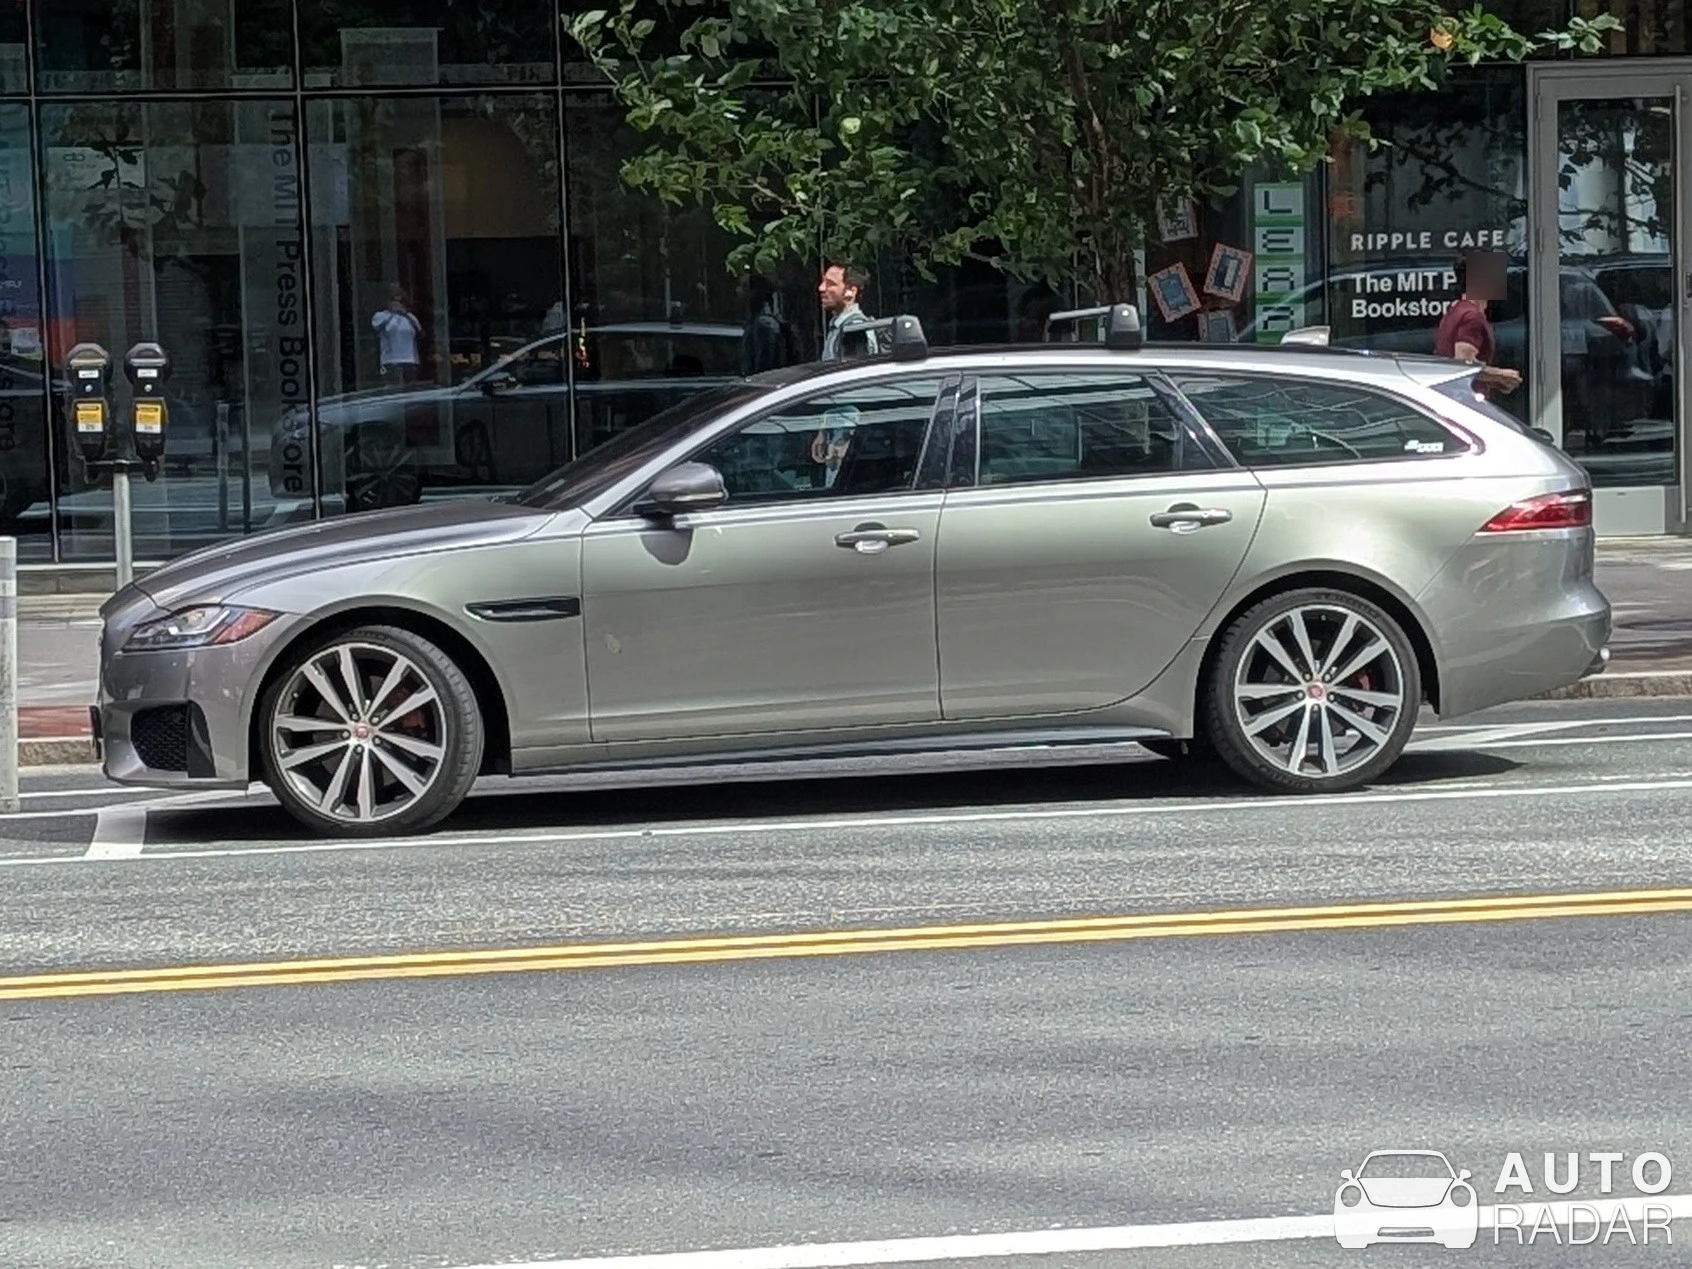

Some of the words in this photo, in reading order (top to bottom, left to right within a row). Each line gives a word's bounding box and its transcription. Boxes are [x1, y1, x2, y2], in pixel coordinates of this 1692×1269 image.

[271, 111, 298, 166] The
[273, 174, 299, 230] MIT
[1350, 232, 1432, 251] RIPPLE
[1443, 230, 1504, 248] CAFE
[276, 240, 302, 325] Press
[1353, 274, 1392, 293] The
[1397, 271, 1440, 292] MIT
[1351, 297, 1459, 318] Bookstor
